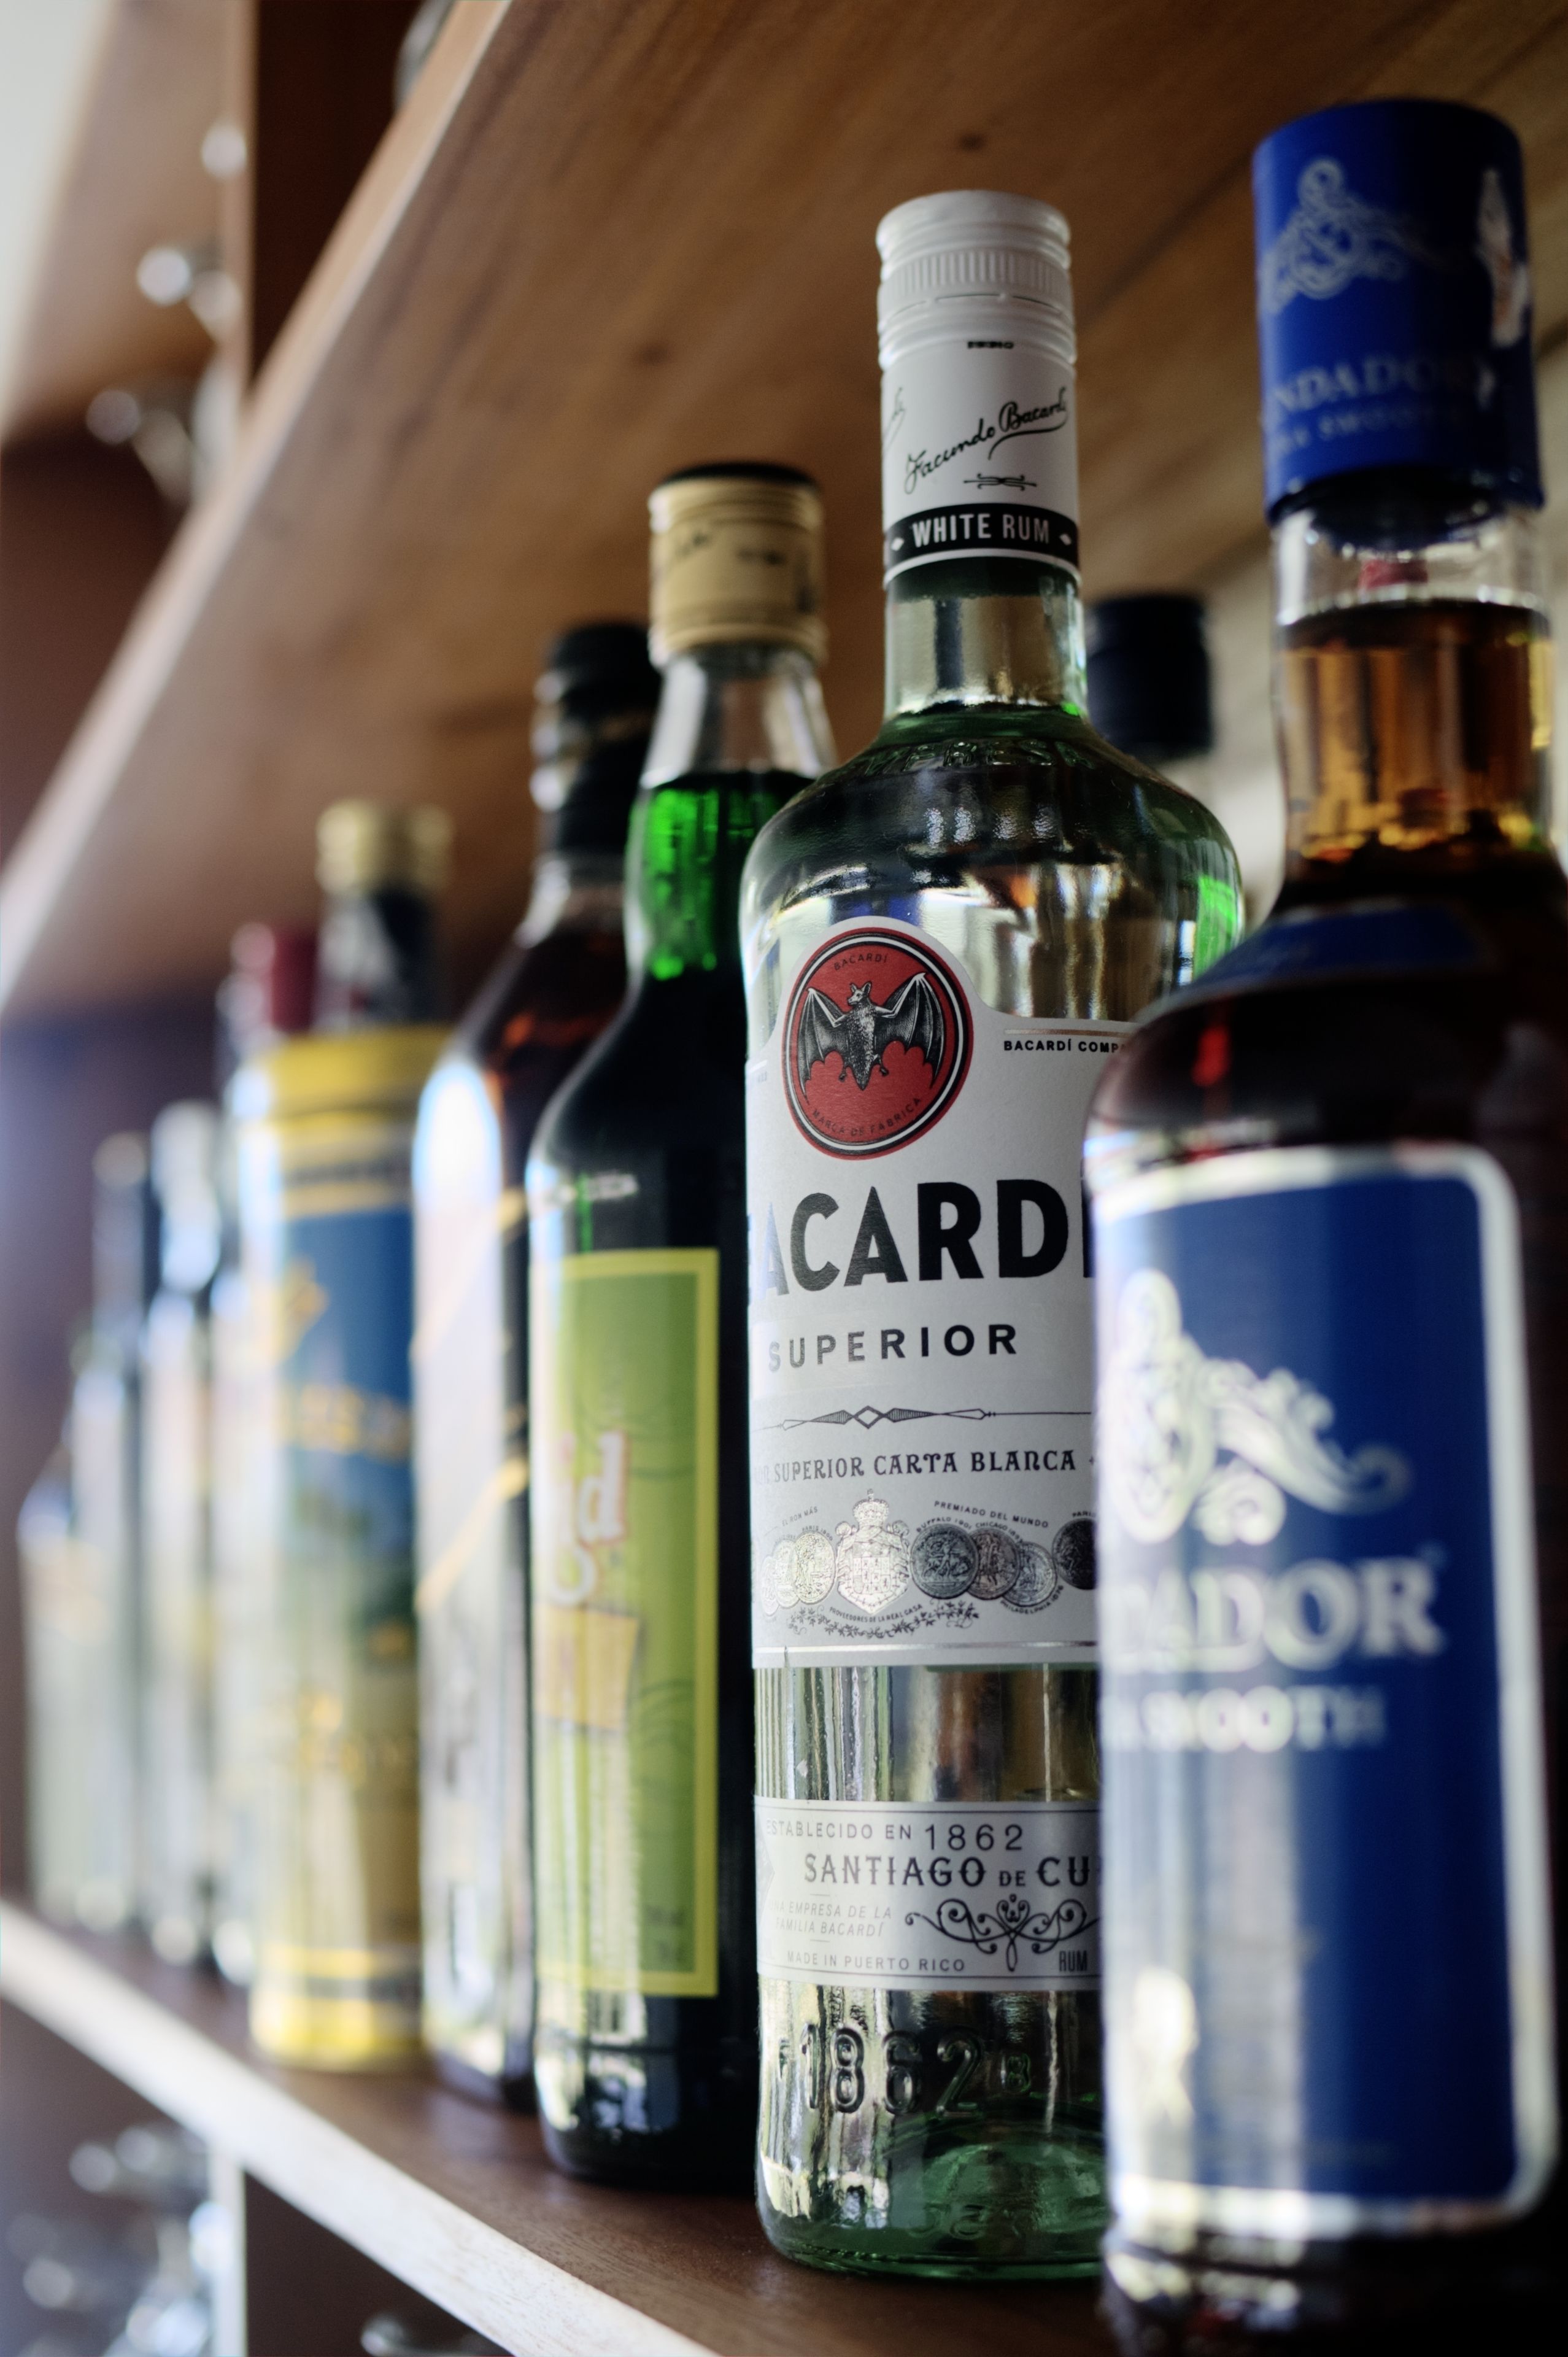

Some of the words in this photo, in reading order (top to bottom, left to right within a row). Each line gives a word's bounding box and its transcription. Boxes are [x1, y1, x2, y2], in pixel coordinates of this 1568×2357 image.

[904, 418, 995, 495] Facundo
[912, 513, 992, 548] WHITE
[1002, 513, 1050, 544] RUM
[1004, 1039, 1072, 1051] BACARDÍ
[1078, 1041, 1126, 1053] COMP
[813, 1109, 845, 1134] MARCA
[851, 1127, 864, 1136] DE
[768, 1324, 1018, 1372] SUPERIOR
[774, 1457, 865, 1484] SUPERIOR
[874, 1450, 959, 1476] CARTA
[971, 1449, 1076, 1474] BLANCA
[790, 1512, 802, 1522] RON
[934, 1500, 986, 1517] PREMIADO
[990, 1511, 1008, 1521] DEL
[1013, 1514, 1049, 1528] MUNDO
[829, 1606, 868, 1623] PROVEEDORES
[886, 1611, 903, 1621] REAL
[904, 1604, 922, 1616] CASA
[767, 1820, 873, 1839] ESTABLECIDO
[885, 1824, 912, 1840] EN
[925, 1824, 1024, 1851] 1862
[804, 1852, 987, 1887] SANTIAGO
[999, 1870, 1025, 1887] DE
[1036, 1855, 1091, 1887] CU
[789, 1901, 841, 1917] EMPRESA
[848, 1905, 866, 1918] DE
[874, 1906, 892, 1919] LA
[775, 1917, 815, 1933] FAMILIA
[787, 1951, 818, 1965] MADE
[824, 1954, 837, 1967] IN
[844, 1955, 910, 1971] PUERTO
[918, 1958, 966, 1972] RICO
[1059, 1950, 1088, 1972] RUM
